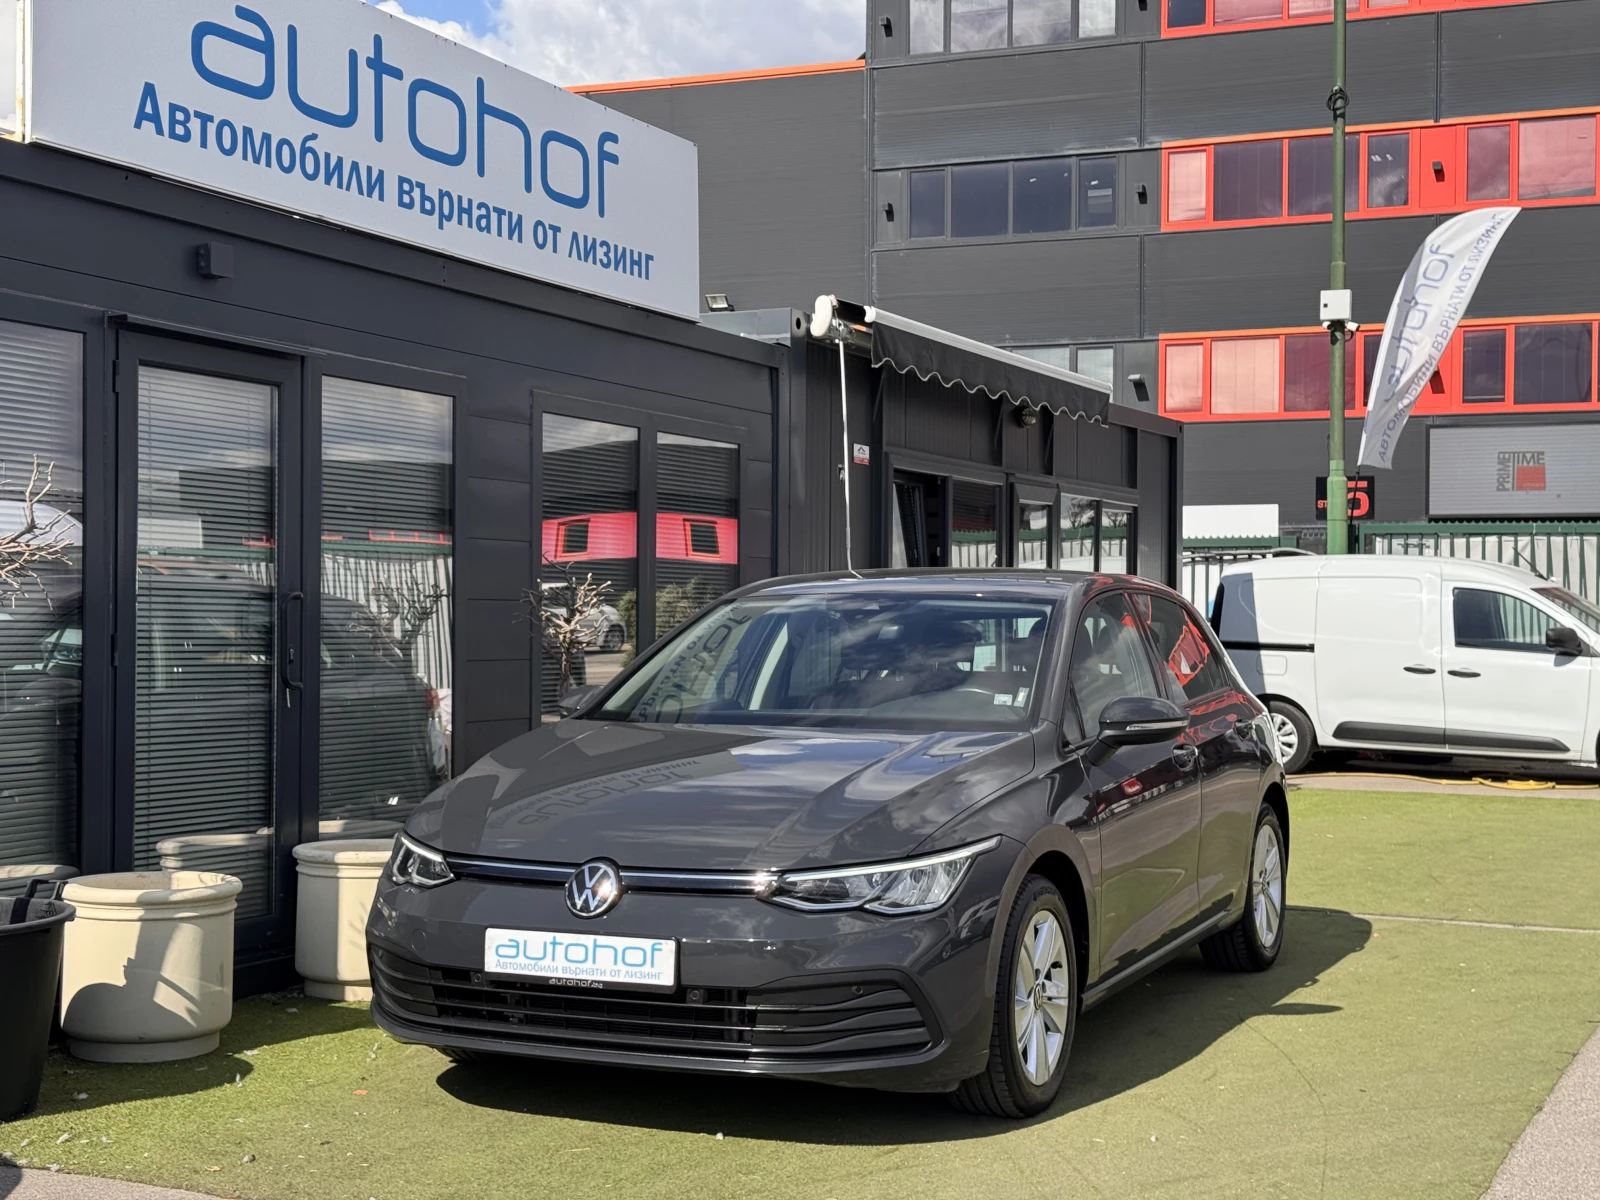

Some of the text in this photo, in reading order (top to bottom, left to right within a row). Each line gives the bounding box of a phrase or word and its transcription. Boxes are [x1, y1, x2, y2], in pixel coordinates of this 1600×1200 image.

[191, 4, 620, 218] autohof
[133, 81, 655, 281] Автомобили върнати от лизинг
[1431, 283, 1468, 353] ВЪРНАТИ
[1458, 264, 1477, 283] ОТ
[1496, 451, 1511, 491] PRIME
[495, 935, 663, 969] autohof
[495, 959, 663, 981] Автомобили върнати от лизинг
